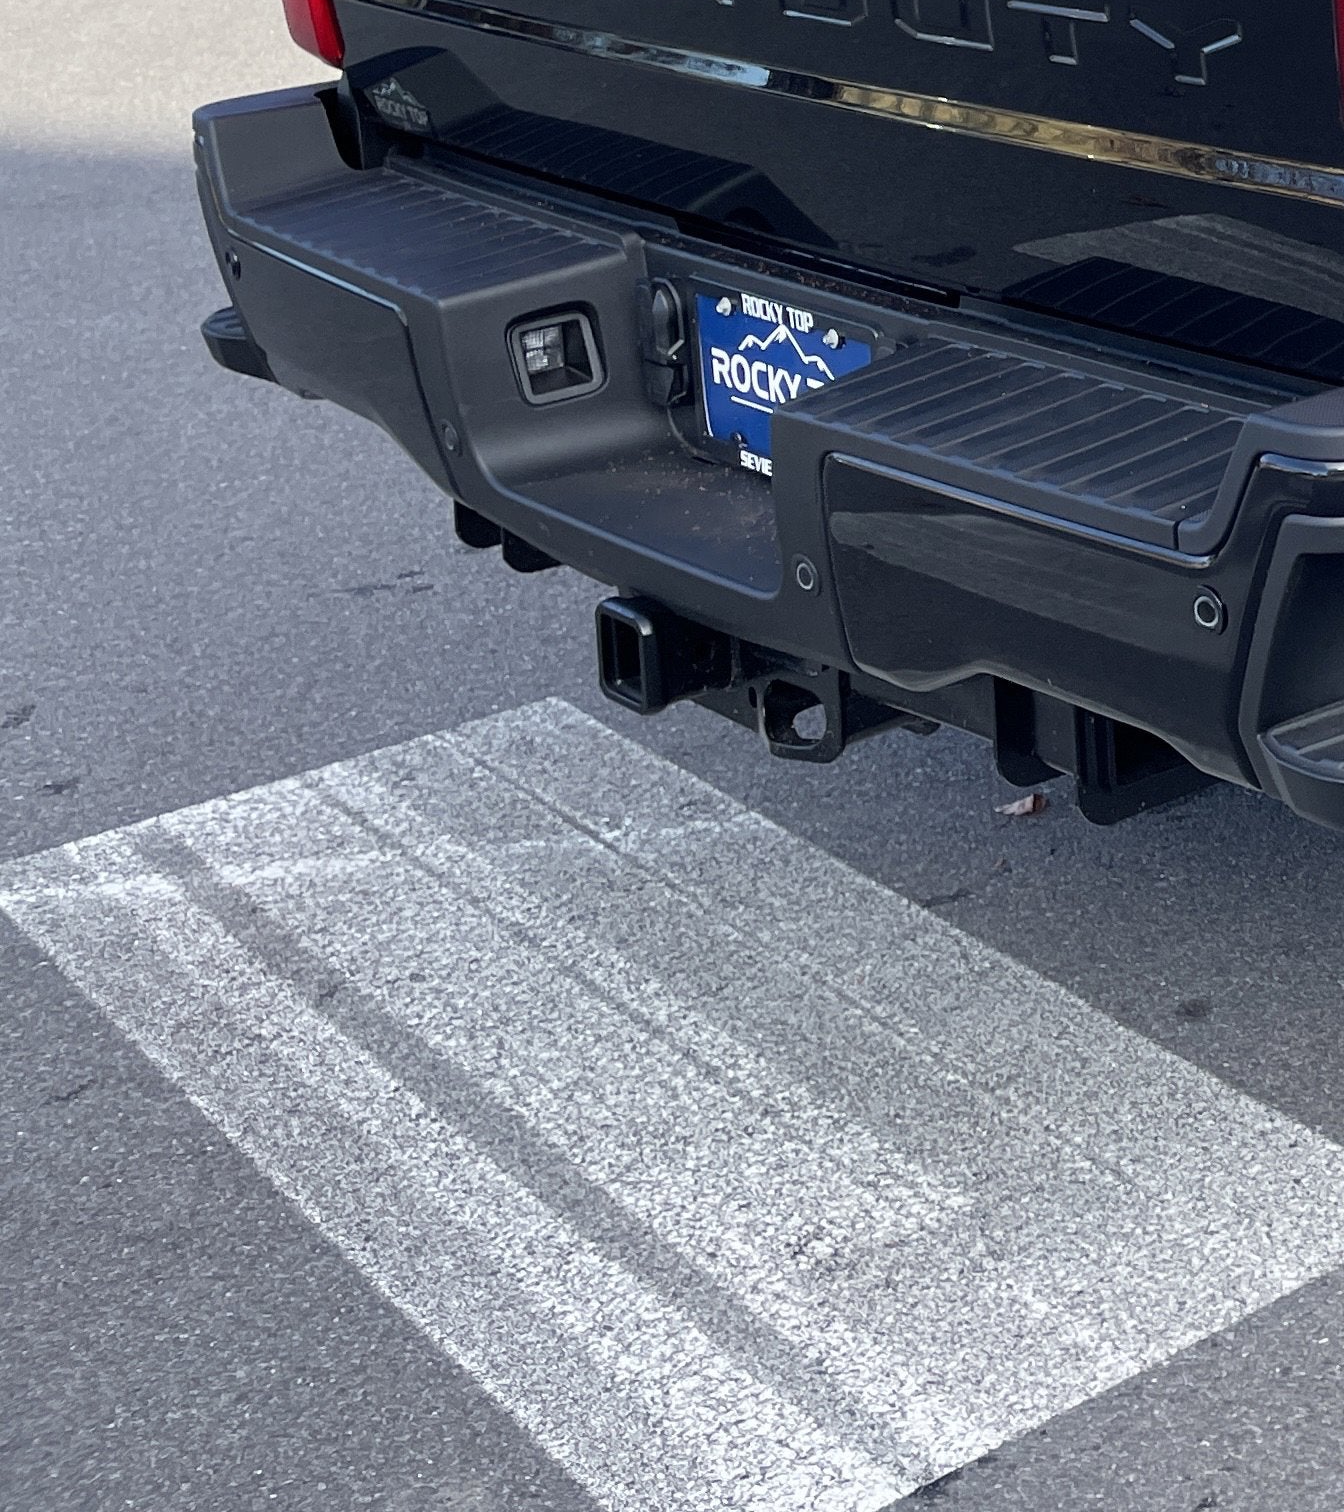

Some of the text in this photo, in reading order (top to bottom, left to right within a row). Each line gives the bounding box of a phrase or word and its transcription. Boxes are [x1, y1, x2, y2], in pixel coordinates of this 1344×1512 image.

[741, 293, 814, 333] ROCKY TOP
[712, 346, 801, 404] ROCKY
